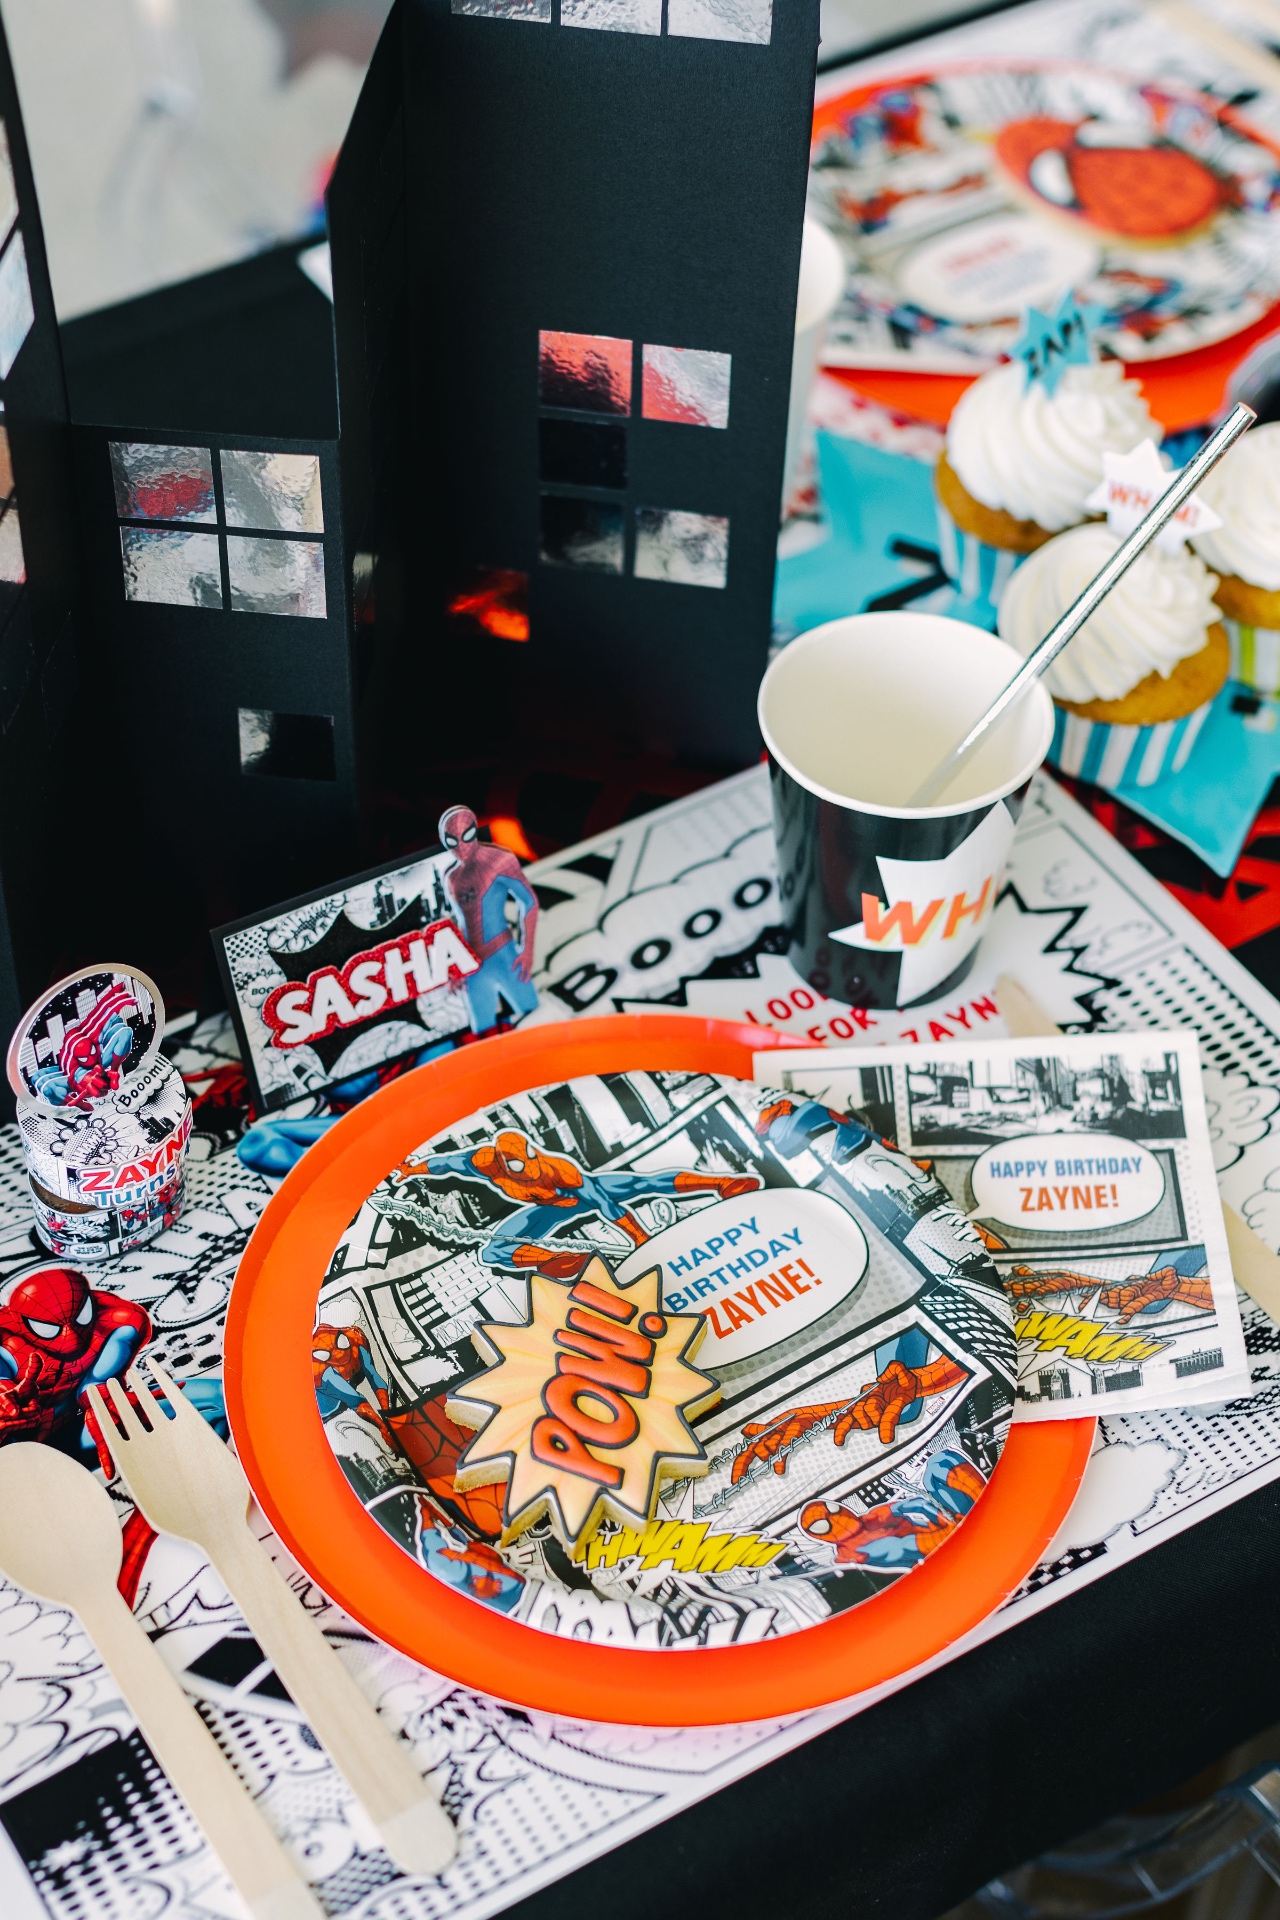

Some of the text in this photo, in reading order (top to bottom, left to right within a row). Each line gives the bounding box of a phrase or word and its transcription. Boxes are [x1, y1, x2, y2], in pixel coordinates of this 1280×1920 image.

[1109, 484, 1199, 528] WHM!
[861, 873, 998, 946] WH
[275, 926, 481, 1045] SASHA
[745, 988, 829, 1028] LOO
[899, 990, 999, 1043] ZAYN
[94, 1163, 177, 1206] Turns
[990, 1156, 1142, 1178] HAPPY BIRTHDAY
[1020, 1184, 1119, 1212] ZAYNE!
[664, 1227, 803, 1313] BIRTHDAY
[667, 1216, 761, 1277] HAPPY
[700, 1258, 823, 1340] ZAYNE!
[531, 1281, 667, 1490] POW!
[575, 1519, 786, 1573] HWAMM
